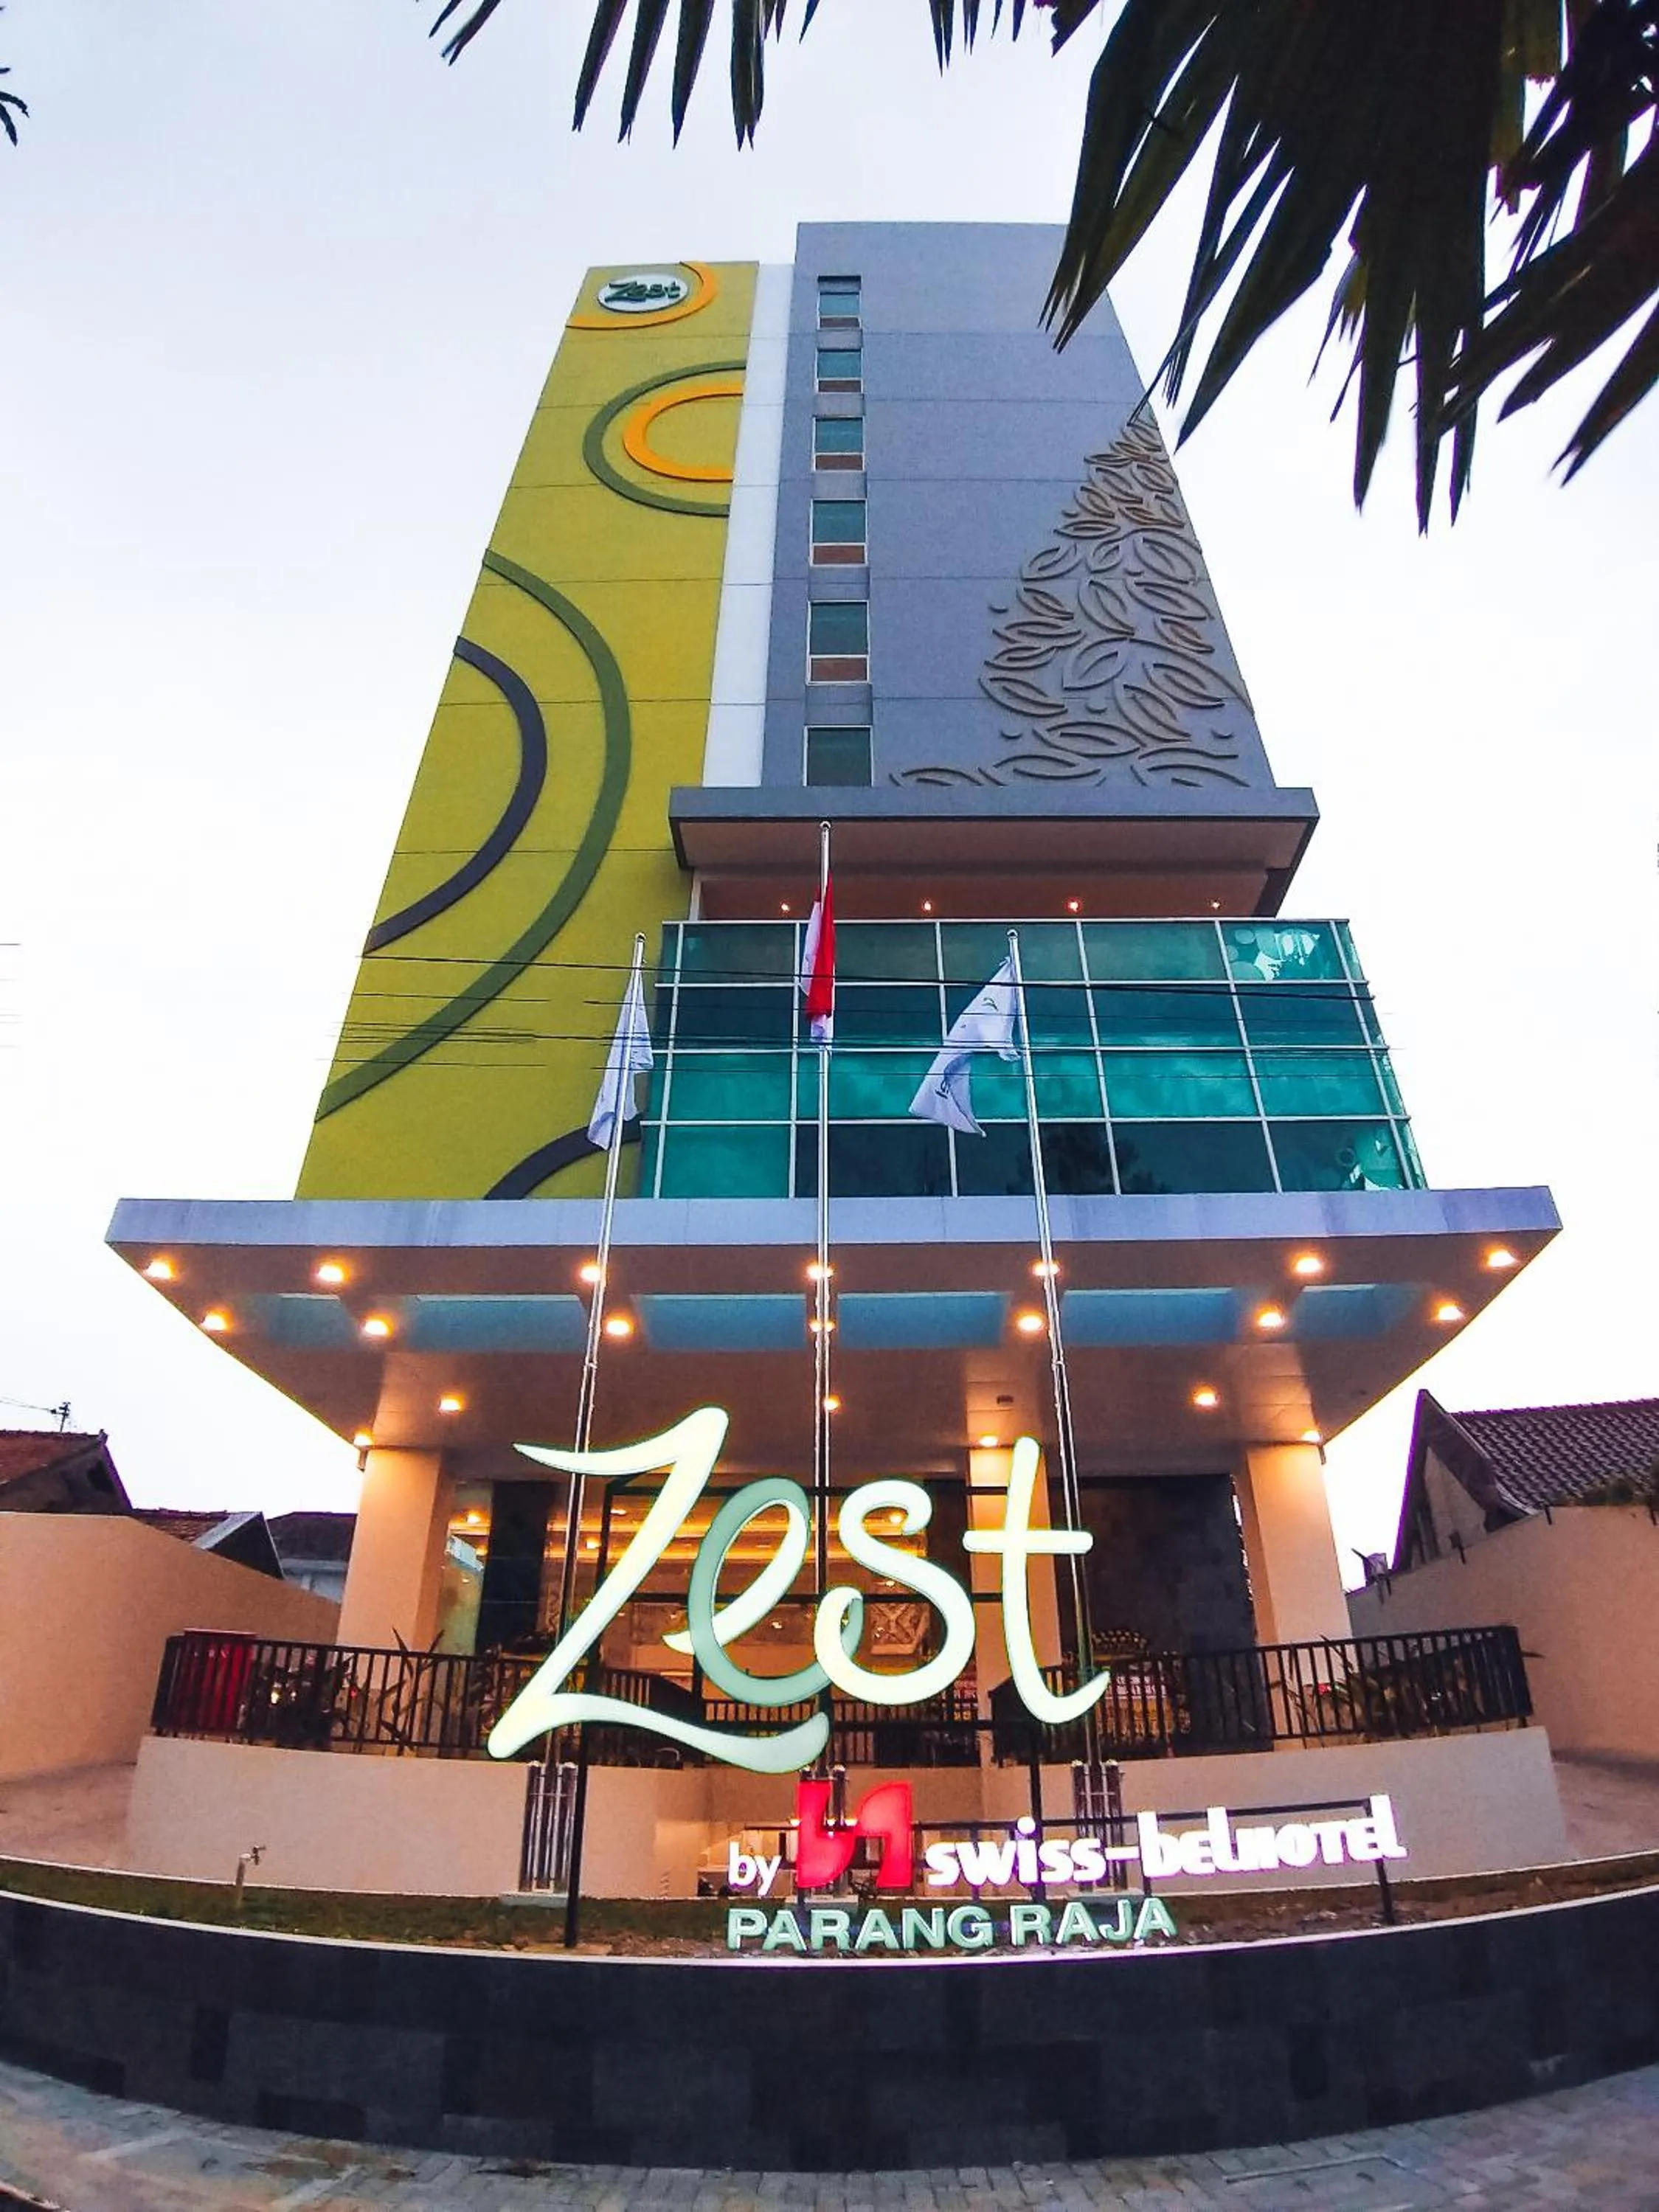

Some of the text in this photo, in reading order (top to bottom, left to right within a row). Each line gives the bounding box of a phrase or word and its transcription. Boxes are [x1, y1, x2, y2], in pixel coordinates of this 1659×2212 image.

[605, 280, 681, 303] Zest
[487, 1406, 1111, 1774] Zest
[728, 1841, 782, 1896] by
[727, 1896, 1180, 1952] PARANG RAJA
